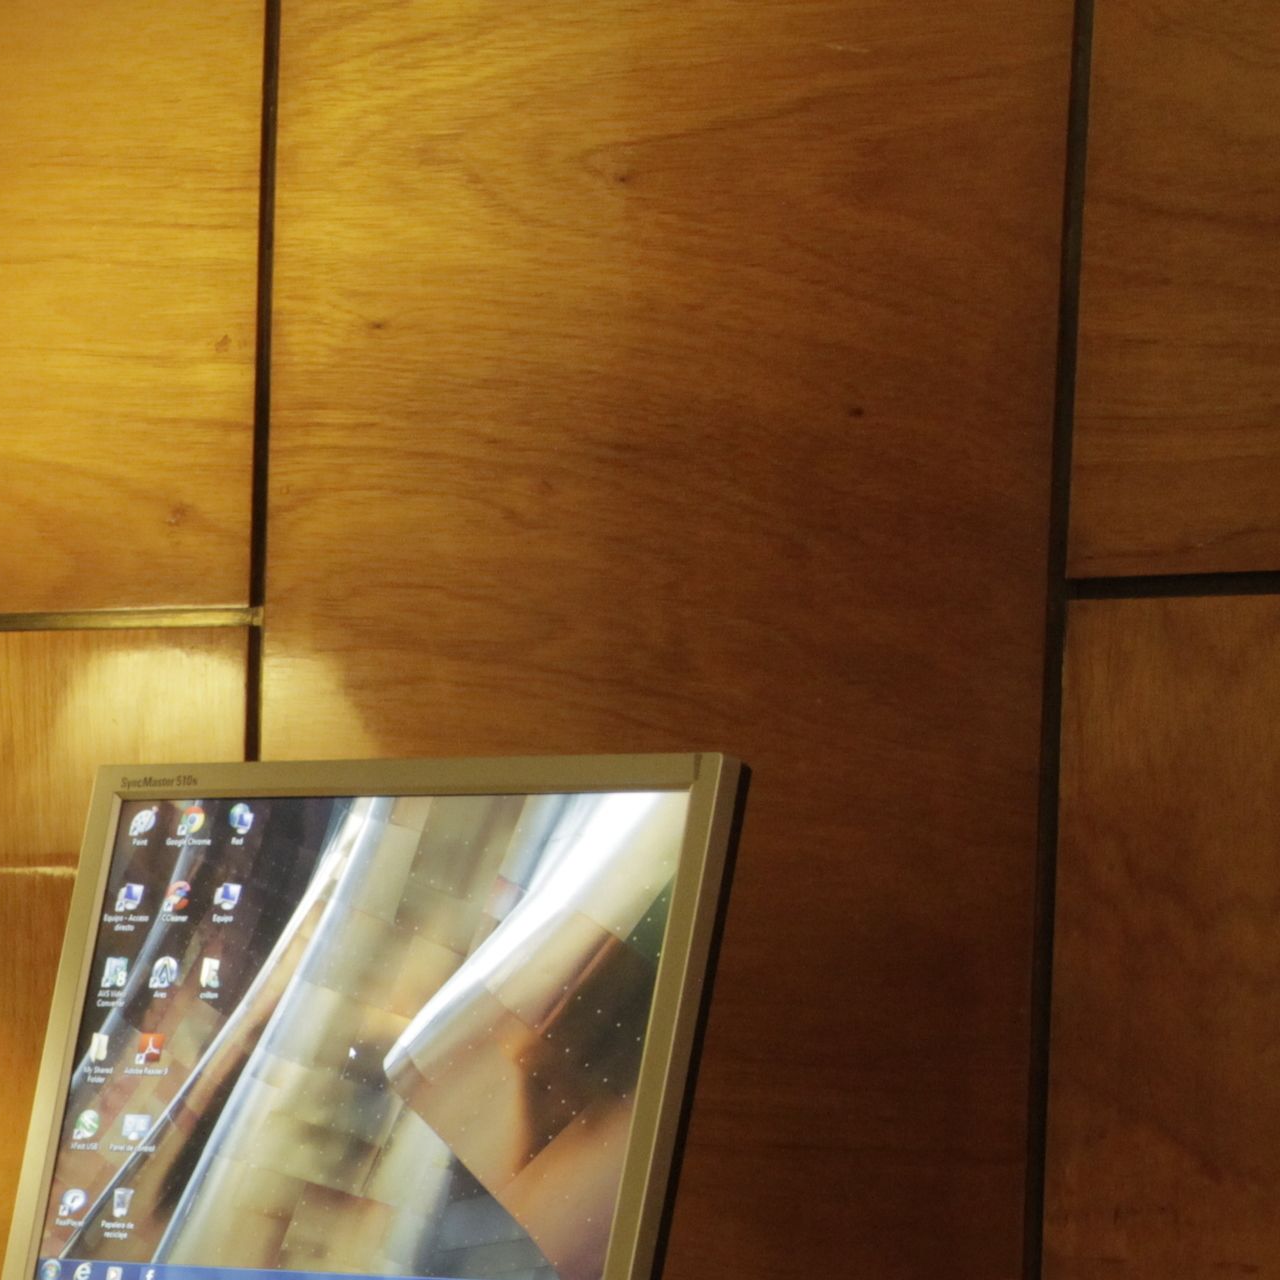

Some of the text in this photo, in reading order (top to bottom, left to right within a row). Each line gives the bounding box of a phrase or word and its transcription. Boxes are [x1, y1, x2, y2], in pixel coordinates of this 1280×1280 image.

[121, 776, 174, 789] SyncMaster
[132, 838, 148, 846] Paint
[165, 837, 212, 847] Google Chrome
